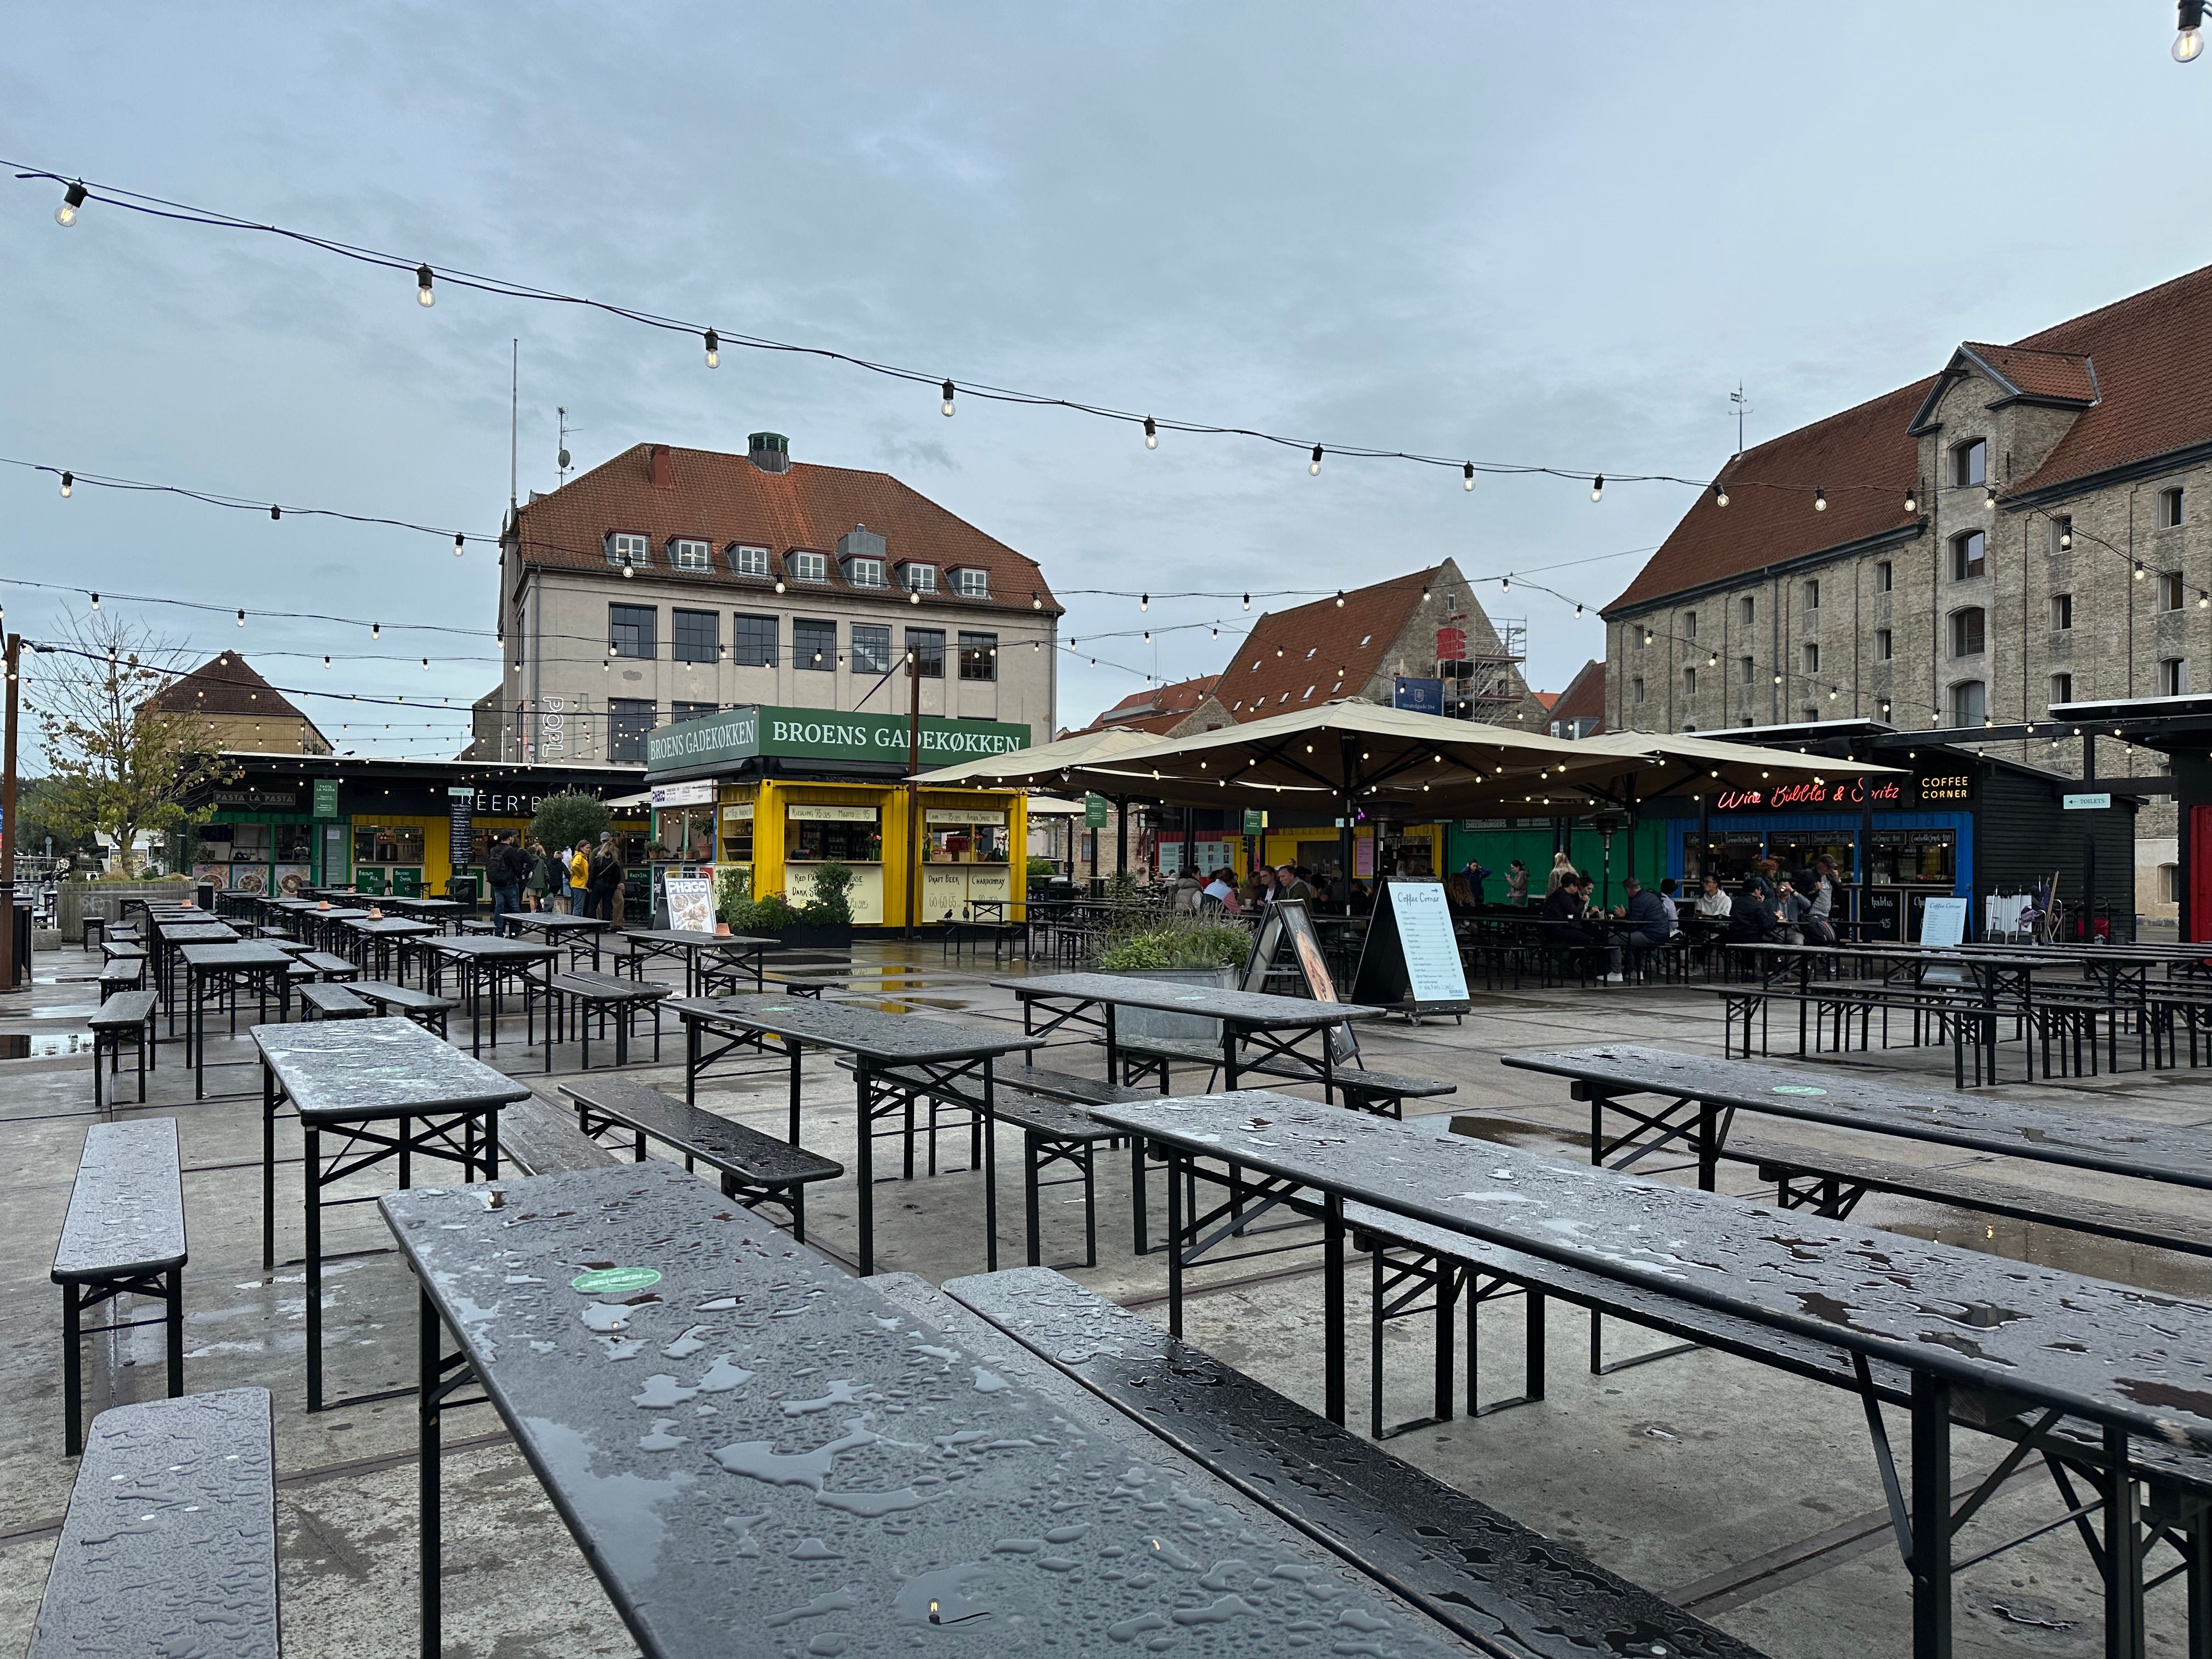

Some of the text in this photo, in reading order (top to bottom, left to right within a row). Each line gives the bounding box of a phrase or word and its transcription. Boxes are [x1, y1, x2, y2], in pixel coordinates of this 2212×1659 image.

[651, 720, 754, 760] BROENS GADEKØKKEN
[772, 721, 867, 746] BROENS
[1922, 776, 1968, 787] COFFEE
[1718, 777, 1899, 808] Wine Bubbles & Sritz
[1922, 790, 1967, 799] CORNER
[928, 874, 960, 885] DRAFT BEER
[1398, 892, 1440, 906] Coffee Corner
[1871, 896, 1893, 909] hablis
